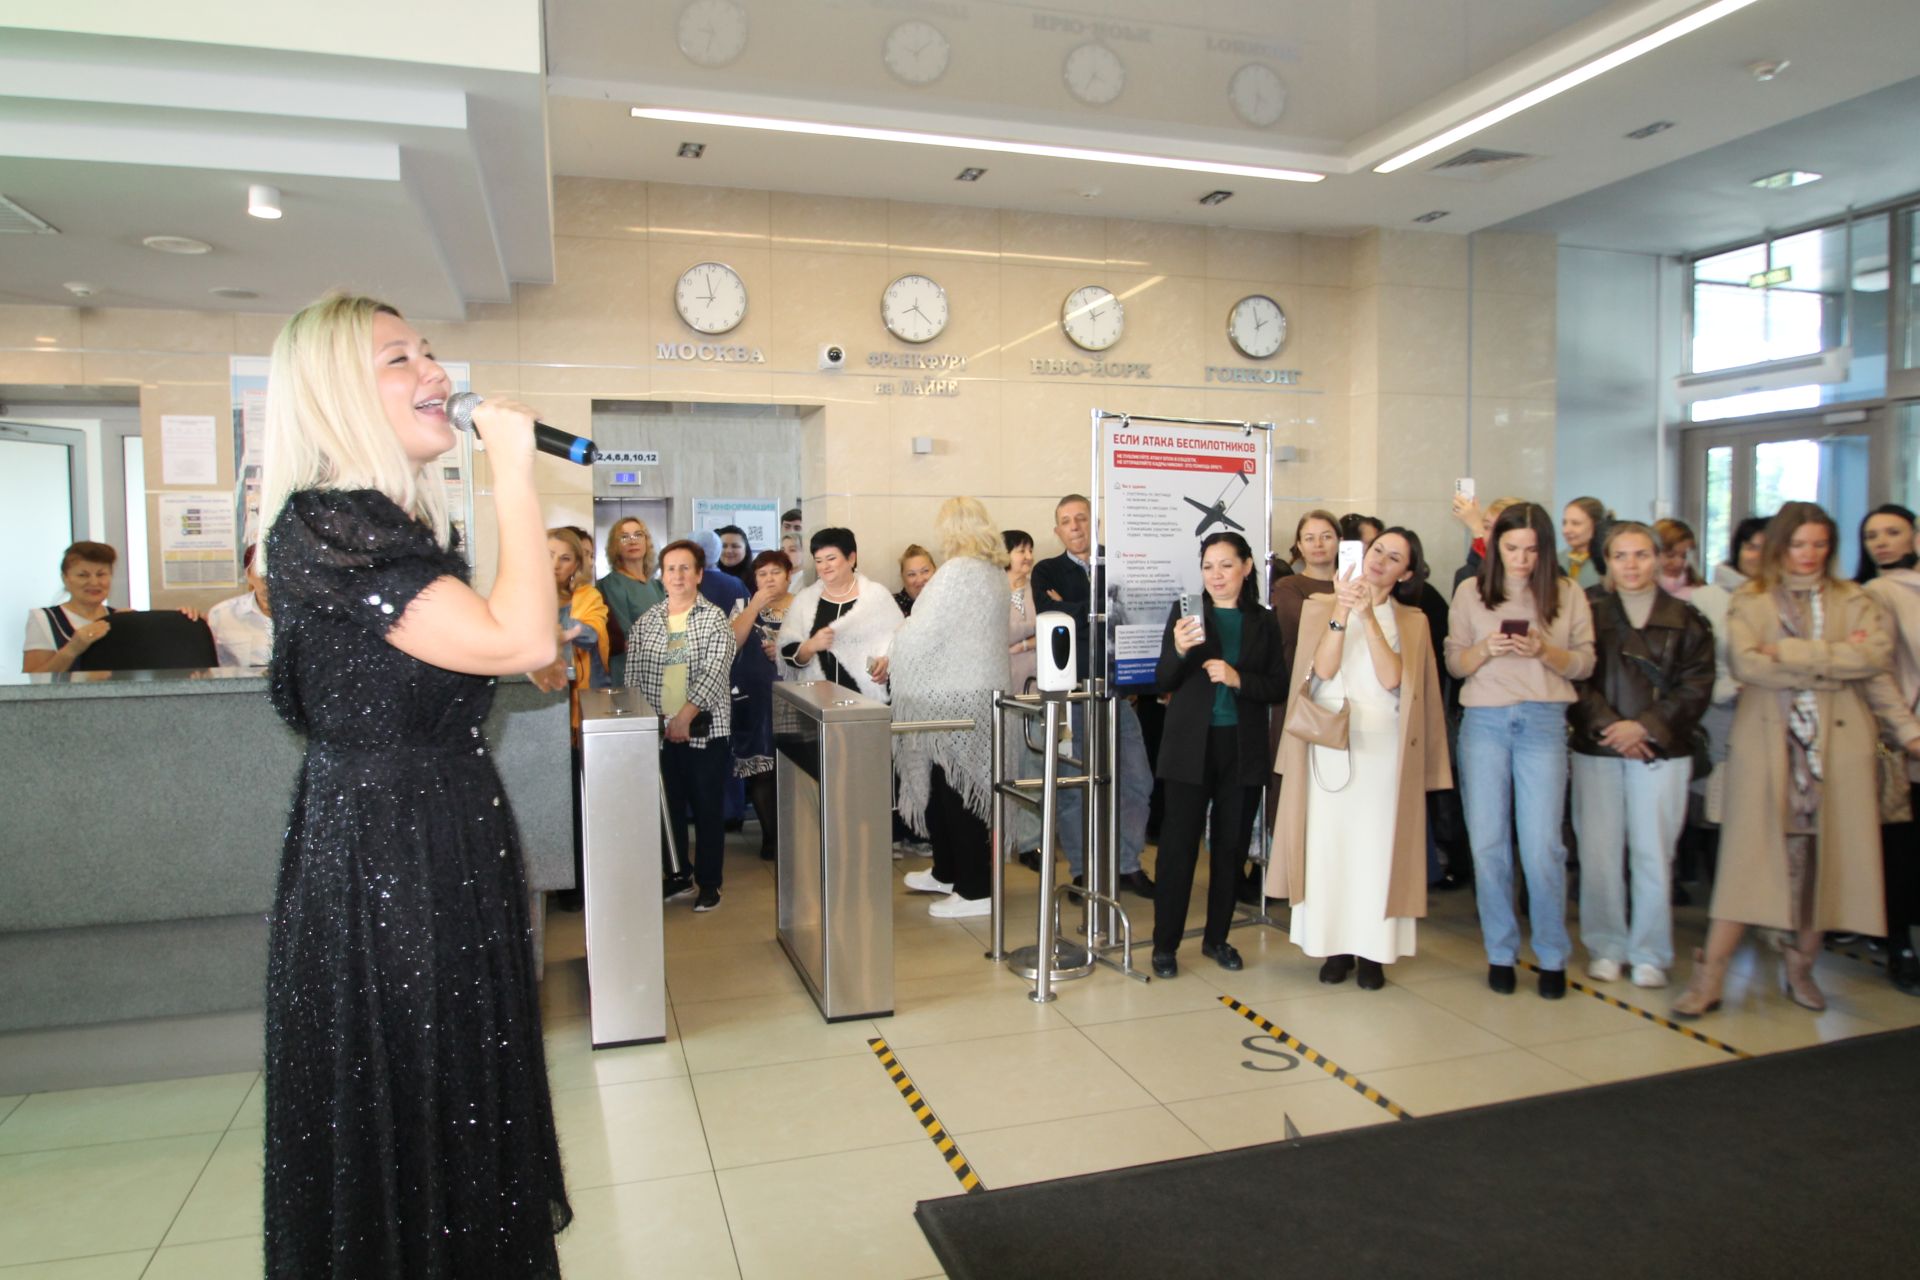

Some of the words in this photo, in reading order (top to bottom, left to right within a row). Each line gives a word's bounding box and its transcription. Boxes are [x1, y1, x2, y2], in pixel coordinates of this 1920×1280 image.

[656, 343, 766, 364] МОСКВА
[1030, 354, 1152, 379] НЬЮ-ЙОРК
[1204, 366, 1303, 385] ГОНКОНГ
[1113, 433, 1140, 446] ЕСЛИ
[1142, 435, 1174, 448] АТАКА
[1176, 438, 1256, 453] БЕСПИЛОТНИКОВ
[710, 503, 776, 511] ИНФОРМАЦИЯ
[1241, 1035, 1300, 1072] S
